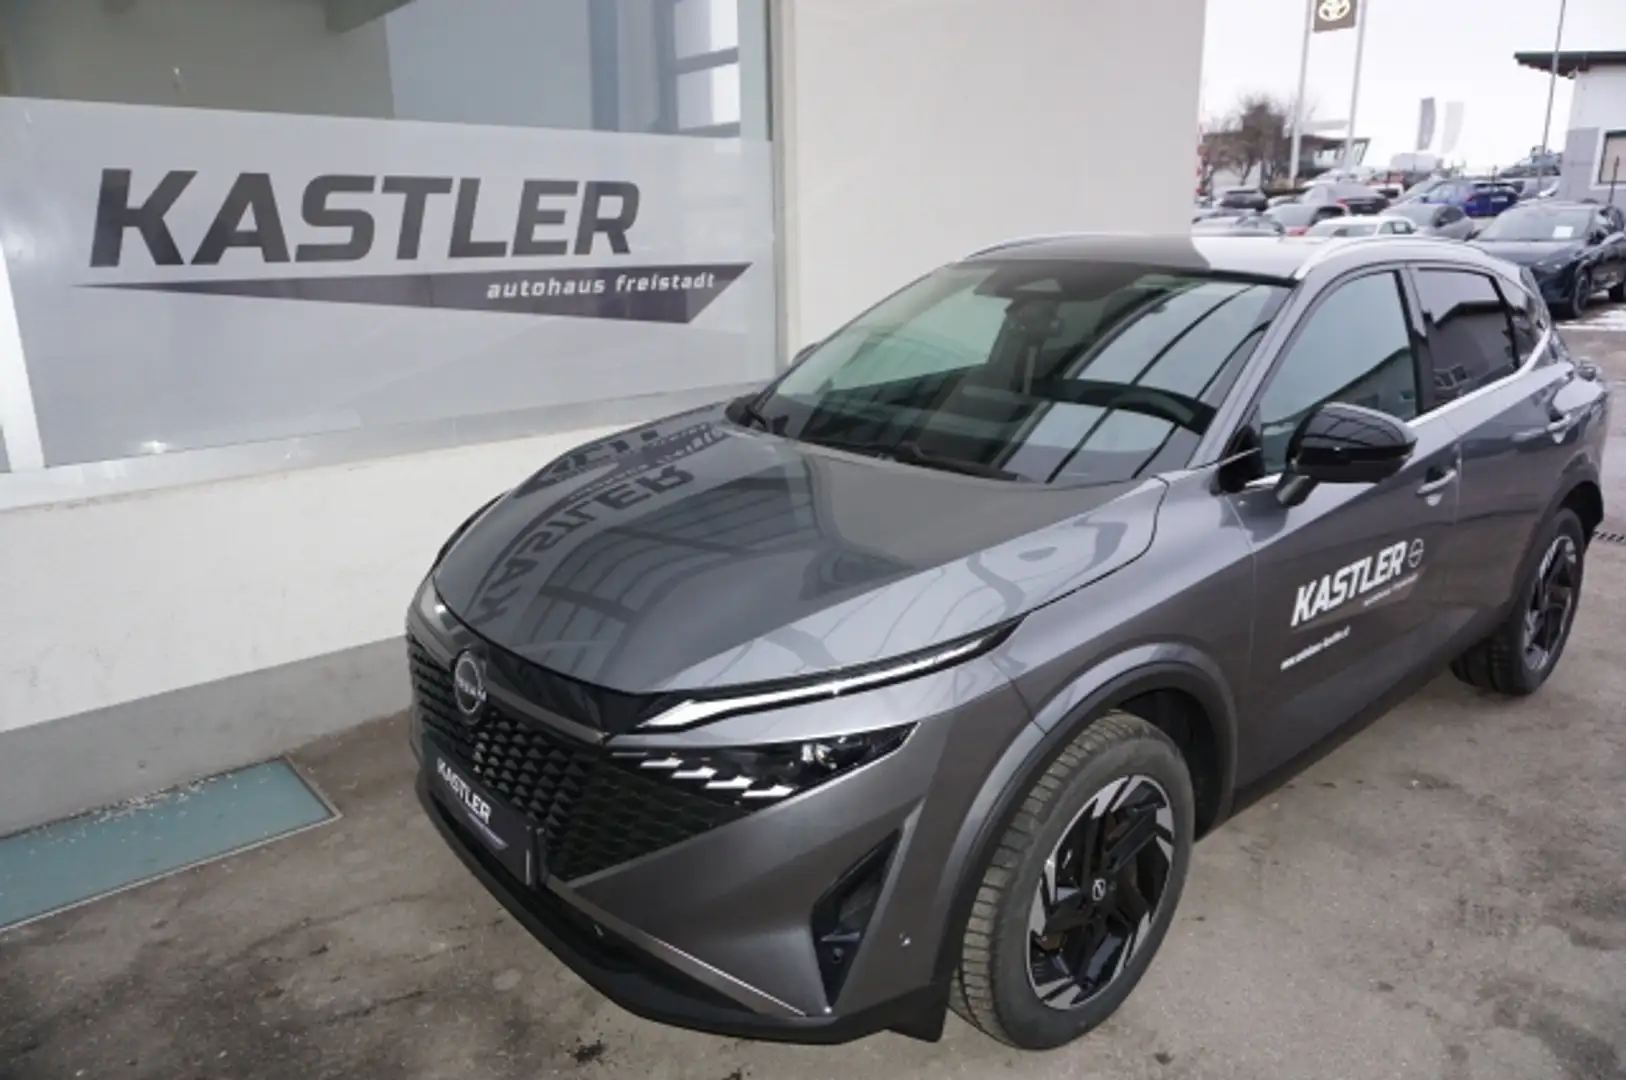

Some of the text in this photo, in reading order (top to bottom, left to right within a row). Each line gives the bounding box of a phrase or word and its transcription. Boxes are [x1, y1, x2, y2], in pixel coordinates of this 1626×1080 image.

[89, 168, 640, 267] KASTLER
[486, 272, 715, 299] autohaus freistadt
[1290, 540, 1408, 627] KASTLER
[437, 757, 492, 825] KASTLER
